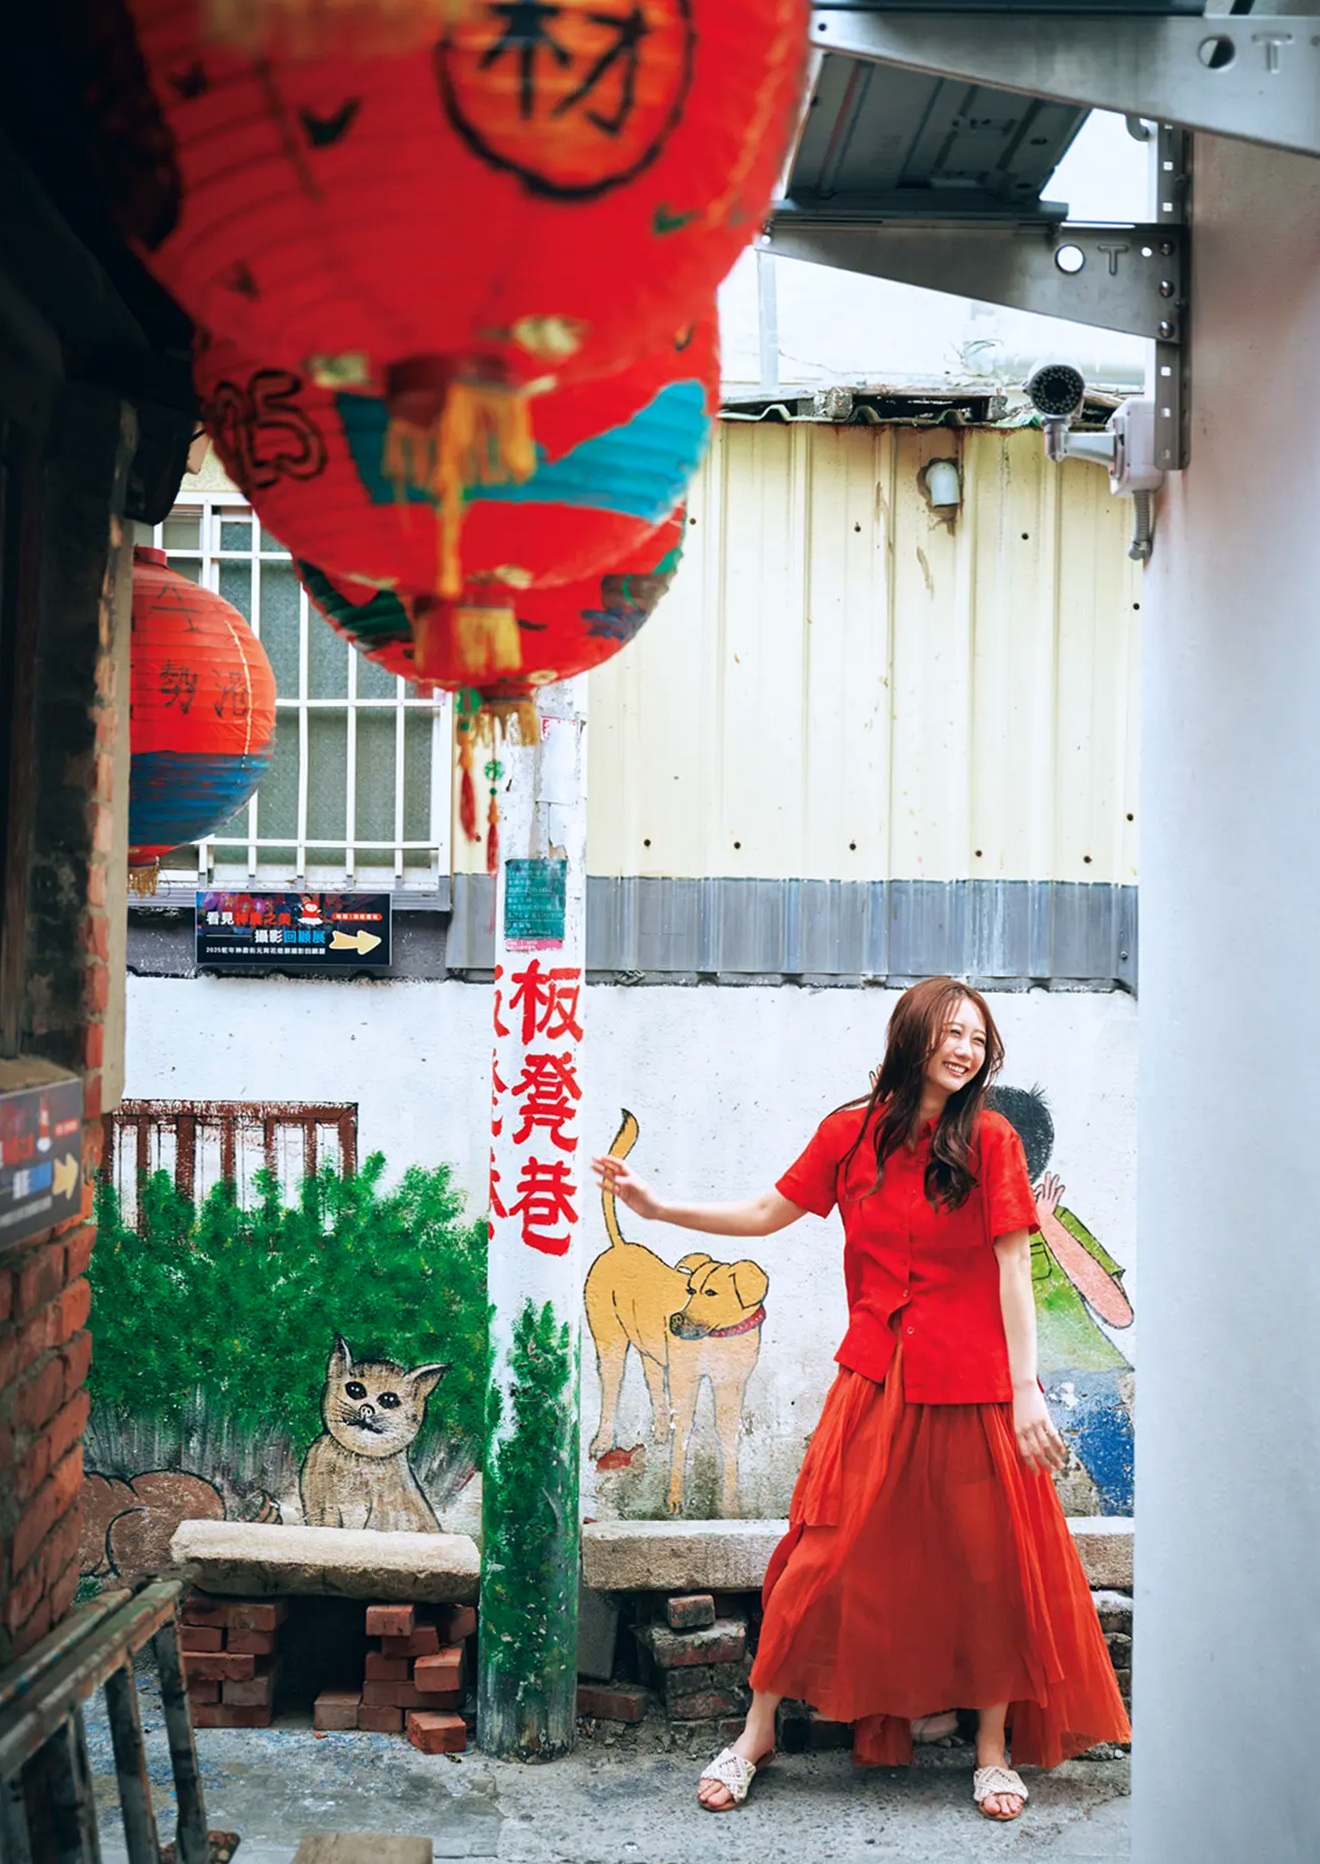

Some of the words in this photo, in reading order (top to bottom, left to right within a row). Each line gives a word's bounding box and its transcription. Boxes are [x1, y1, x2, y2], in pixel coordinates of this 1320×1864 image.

[254, 929, 326, 944] 攝影回顧展
[508, 958, 584, 1257] 板凳巷
